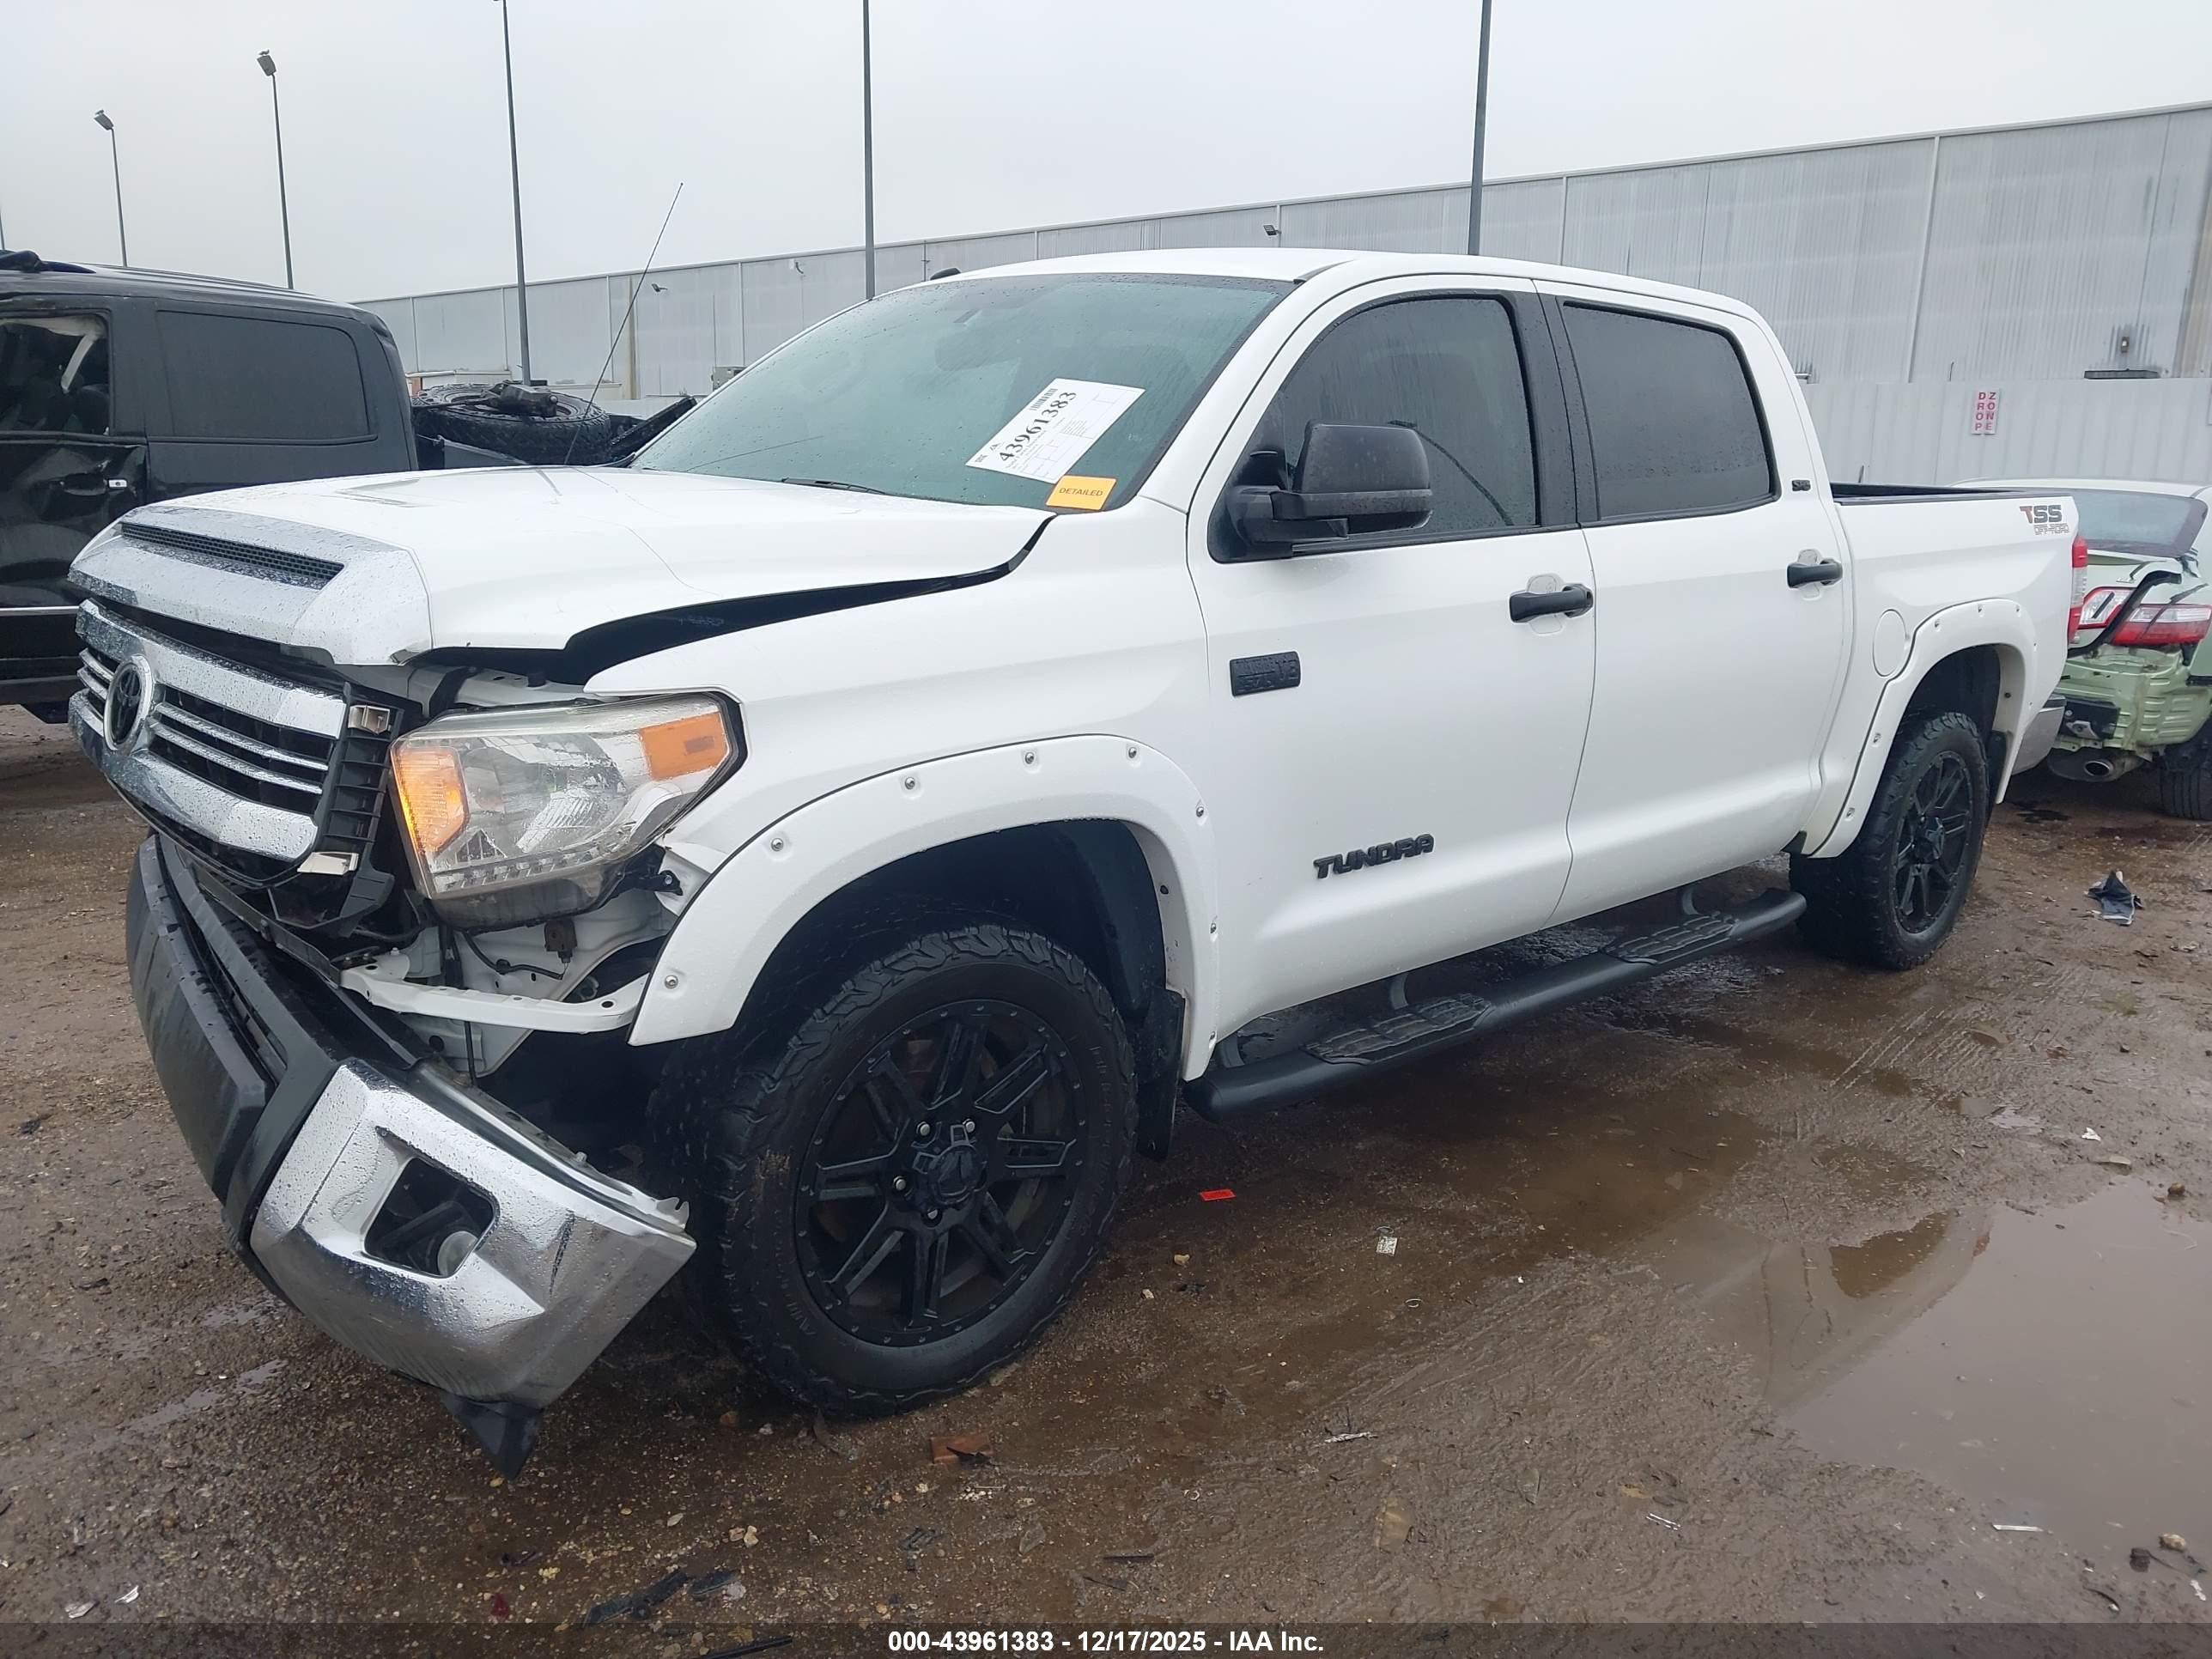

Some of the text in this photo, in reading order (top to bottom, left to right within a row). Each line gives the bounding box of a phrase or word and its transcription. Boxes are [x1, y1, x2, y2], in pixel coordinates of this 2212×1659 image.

[999, 391, 1077, 462] 43961383
[1059, 486, 1103, 496] DETAILED
[2020, 505, 2062, 524] TSS
[1313, 833, 1435, 879] TUNDRA
